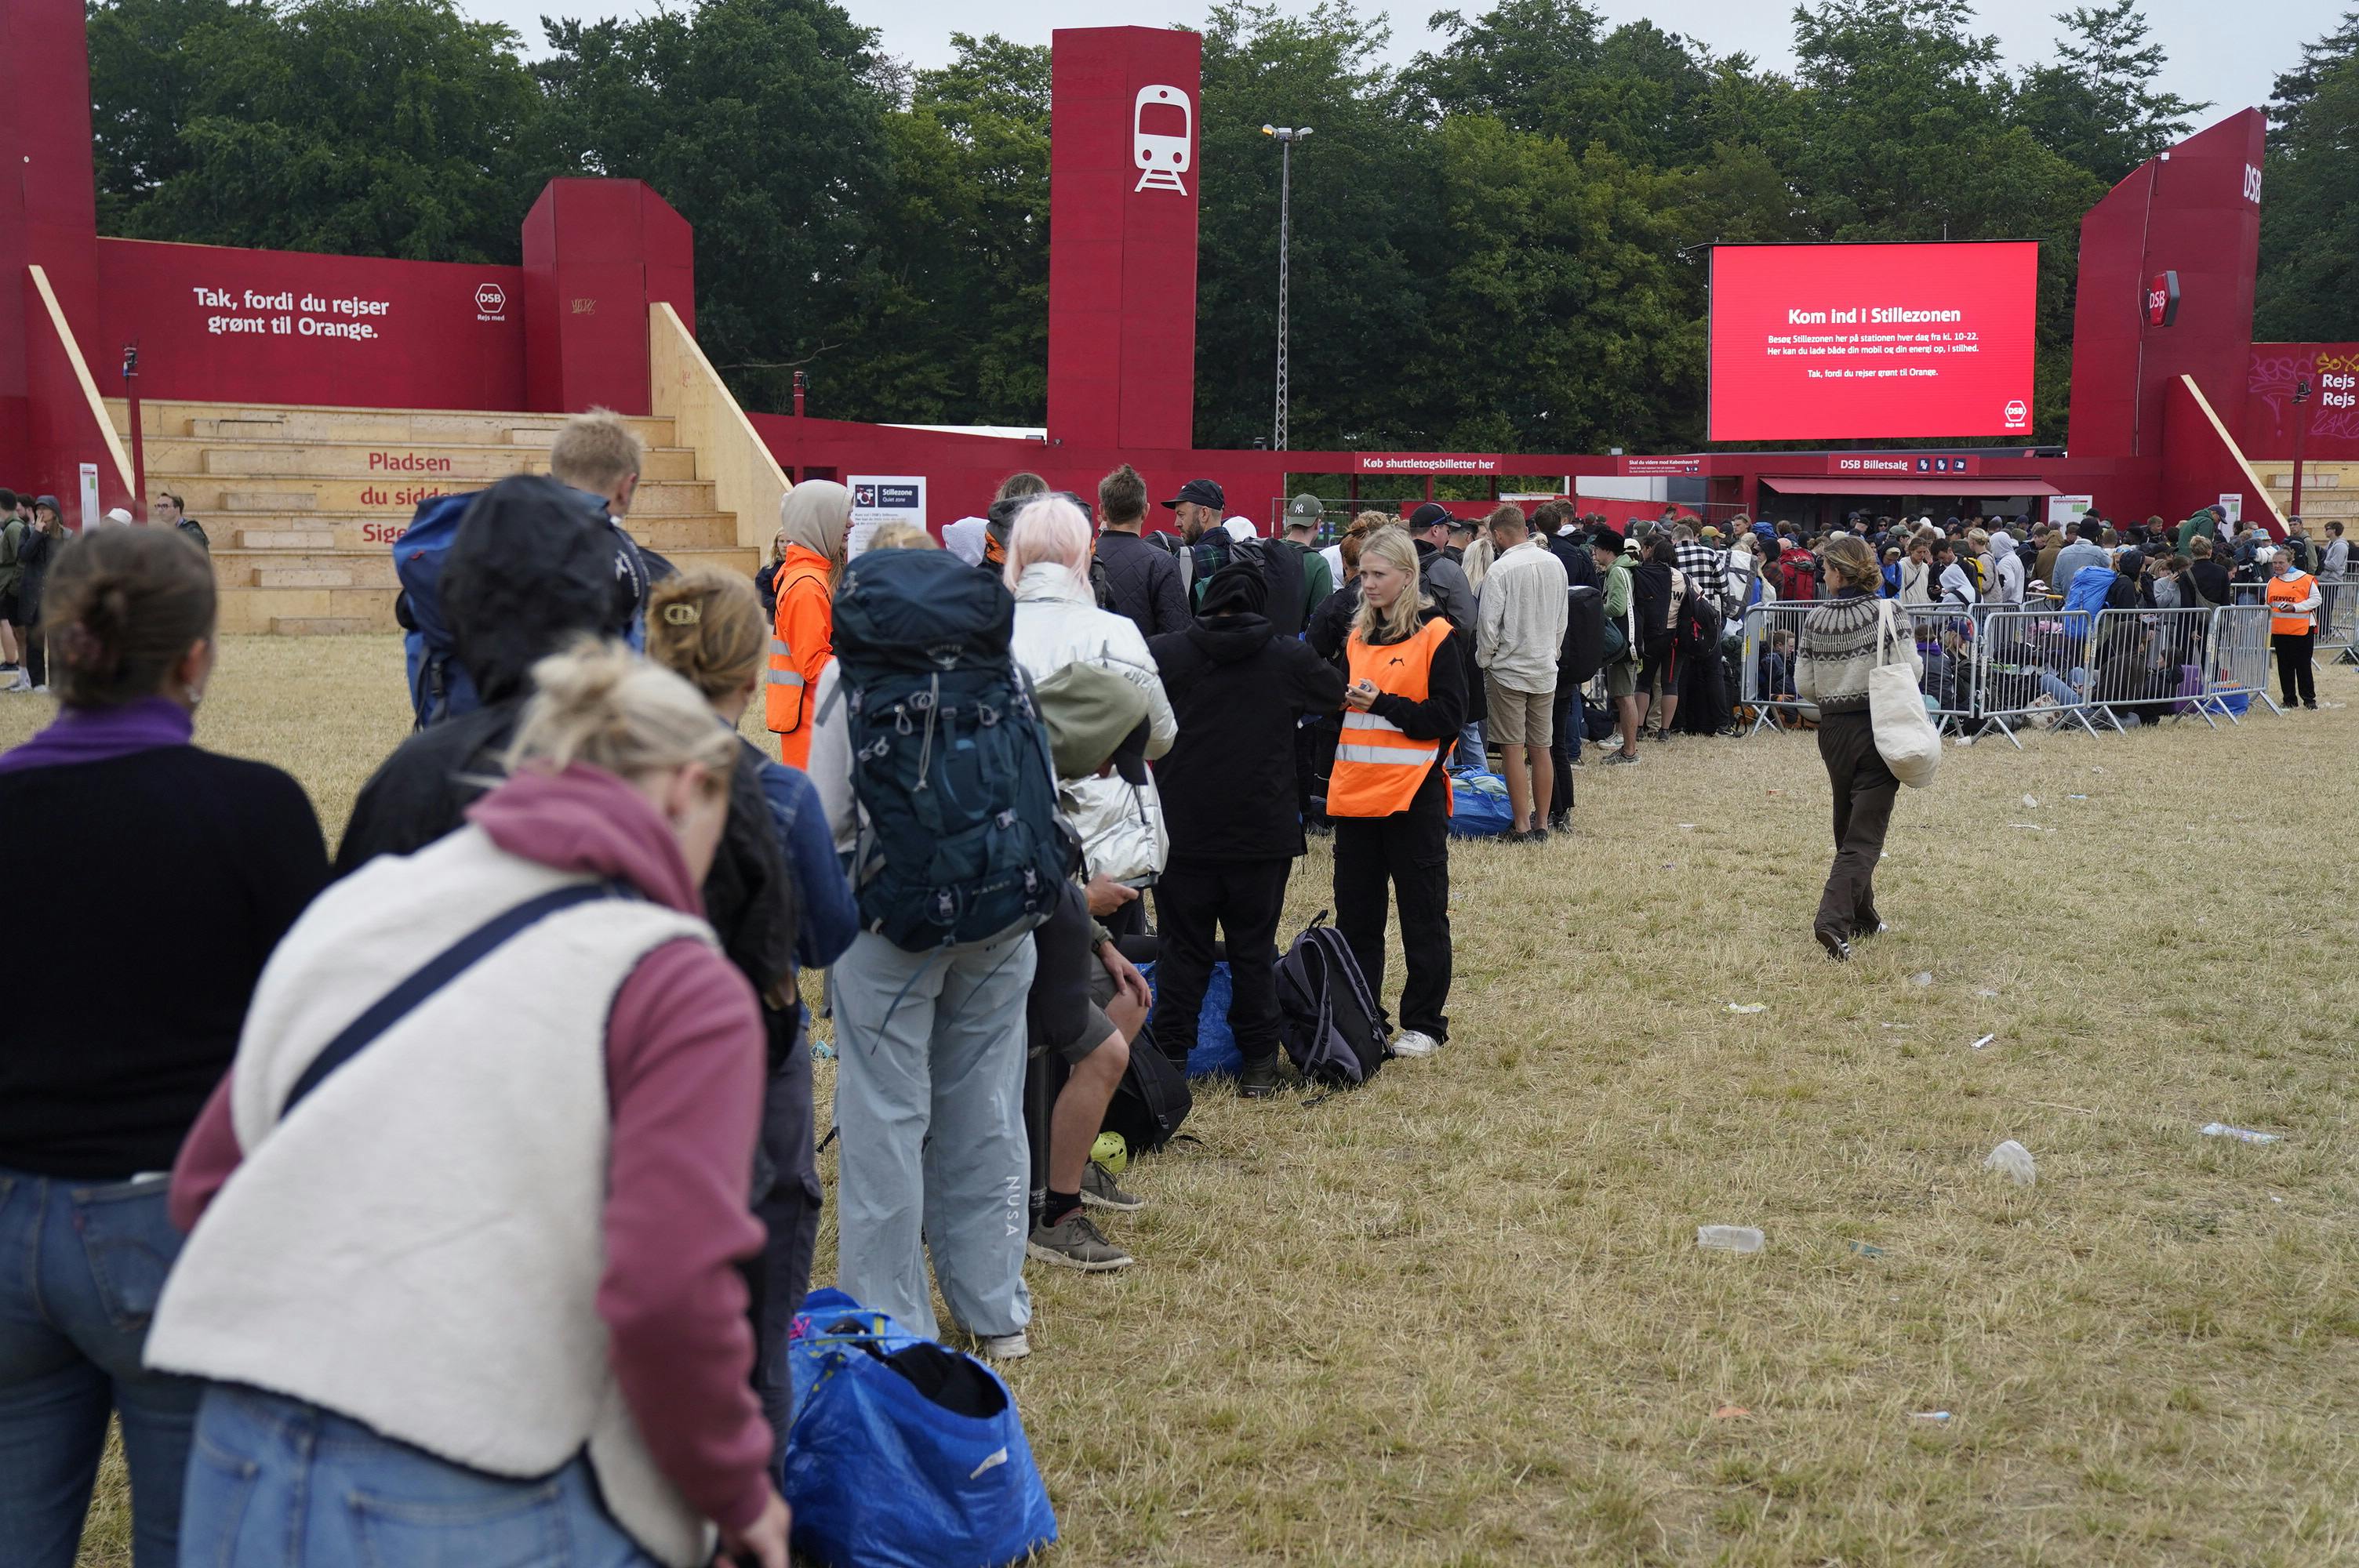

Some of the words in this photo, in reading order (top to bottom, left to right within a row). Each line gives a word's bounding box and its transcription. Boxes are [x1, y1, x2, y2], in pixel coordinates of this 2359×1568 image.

[2244, 163, 2262, 204] DSB
[193, 287, 238, 310] Tak,
[244, 289, 293, 310] fordi
[300, 293, 326, 312] du
[333, 296, 390, 318] rejser
[479, 293, 502, 303] DSB
[2150, 290, 2165, 309] DSB
[1788, 308, 1826, 325] Kom
[1831, 307, 1857, 324] ind
[1861, 307, 1866, 323] i
[1870, 307, 1961, 324] Stillezonen
[208, 315, 265, 335] grønt
[271, 316, 291, 334] til
[298, 317, 378, 341] Orange.
[1768, 335, 1792, 344] Besøg
[1793, 335, 1834, 343] Stillezonen
[1849, 333, 1859, 343] på
[1860, 333, 1896, 343] stationen
[1897, 333, 1914, 342] hver
[1915, 332, 1929, 342] dag
[1930, 332, 1941, 341] fra
[1783, 347, 1797, 355] kan
[1809, 346, 1826, 354] lade
[1827, 346, 1846, 354] både
[1861, 345, 1882, 354] mobil
[1896, 345, 1907, 354] din
[1908, 345, 1932, 354] energi
[1807, 369, 1823, 379] Tak,
[1855, 369, 1876, 379] rejser
[1877, 369, 1898, 378] grønt
[1909, 368, 1939, 377] Orange.
[2322, 373, 2356, 390] Rejs
[2322, 392, 2356, 408] Rejs
[369, 452, 451, 471] Pladsen
[1363, 458, 1383, 468] Køb
[1386, 458, 1476, 470] shuttletogsbilletter
[1478, 459, 1495, 469] her
[1840, 459, 1861, 469] DSB
[1863, 459, 1908, 471] Billetsalg
[361, 486, 387, 506] du
[1005, 1176, 1021, 1236] NUSA
